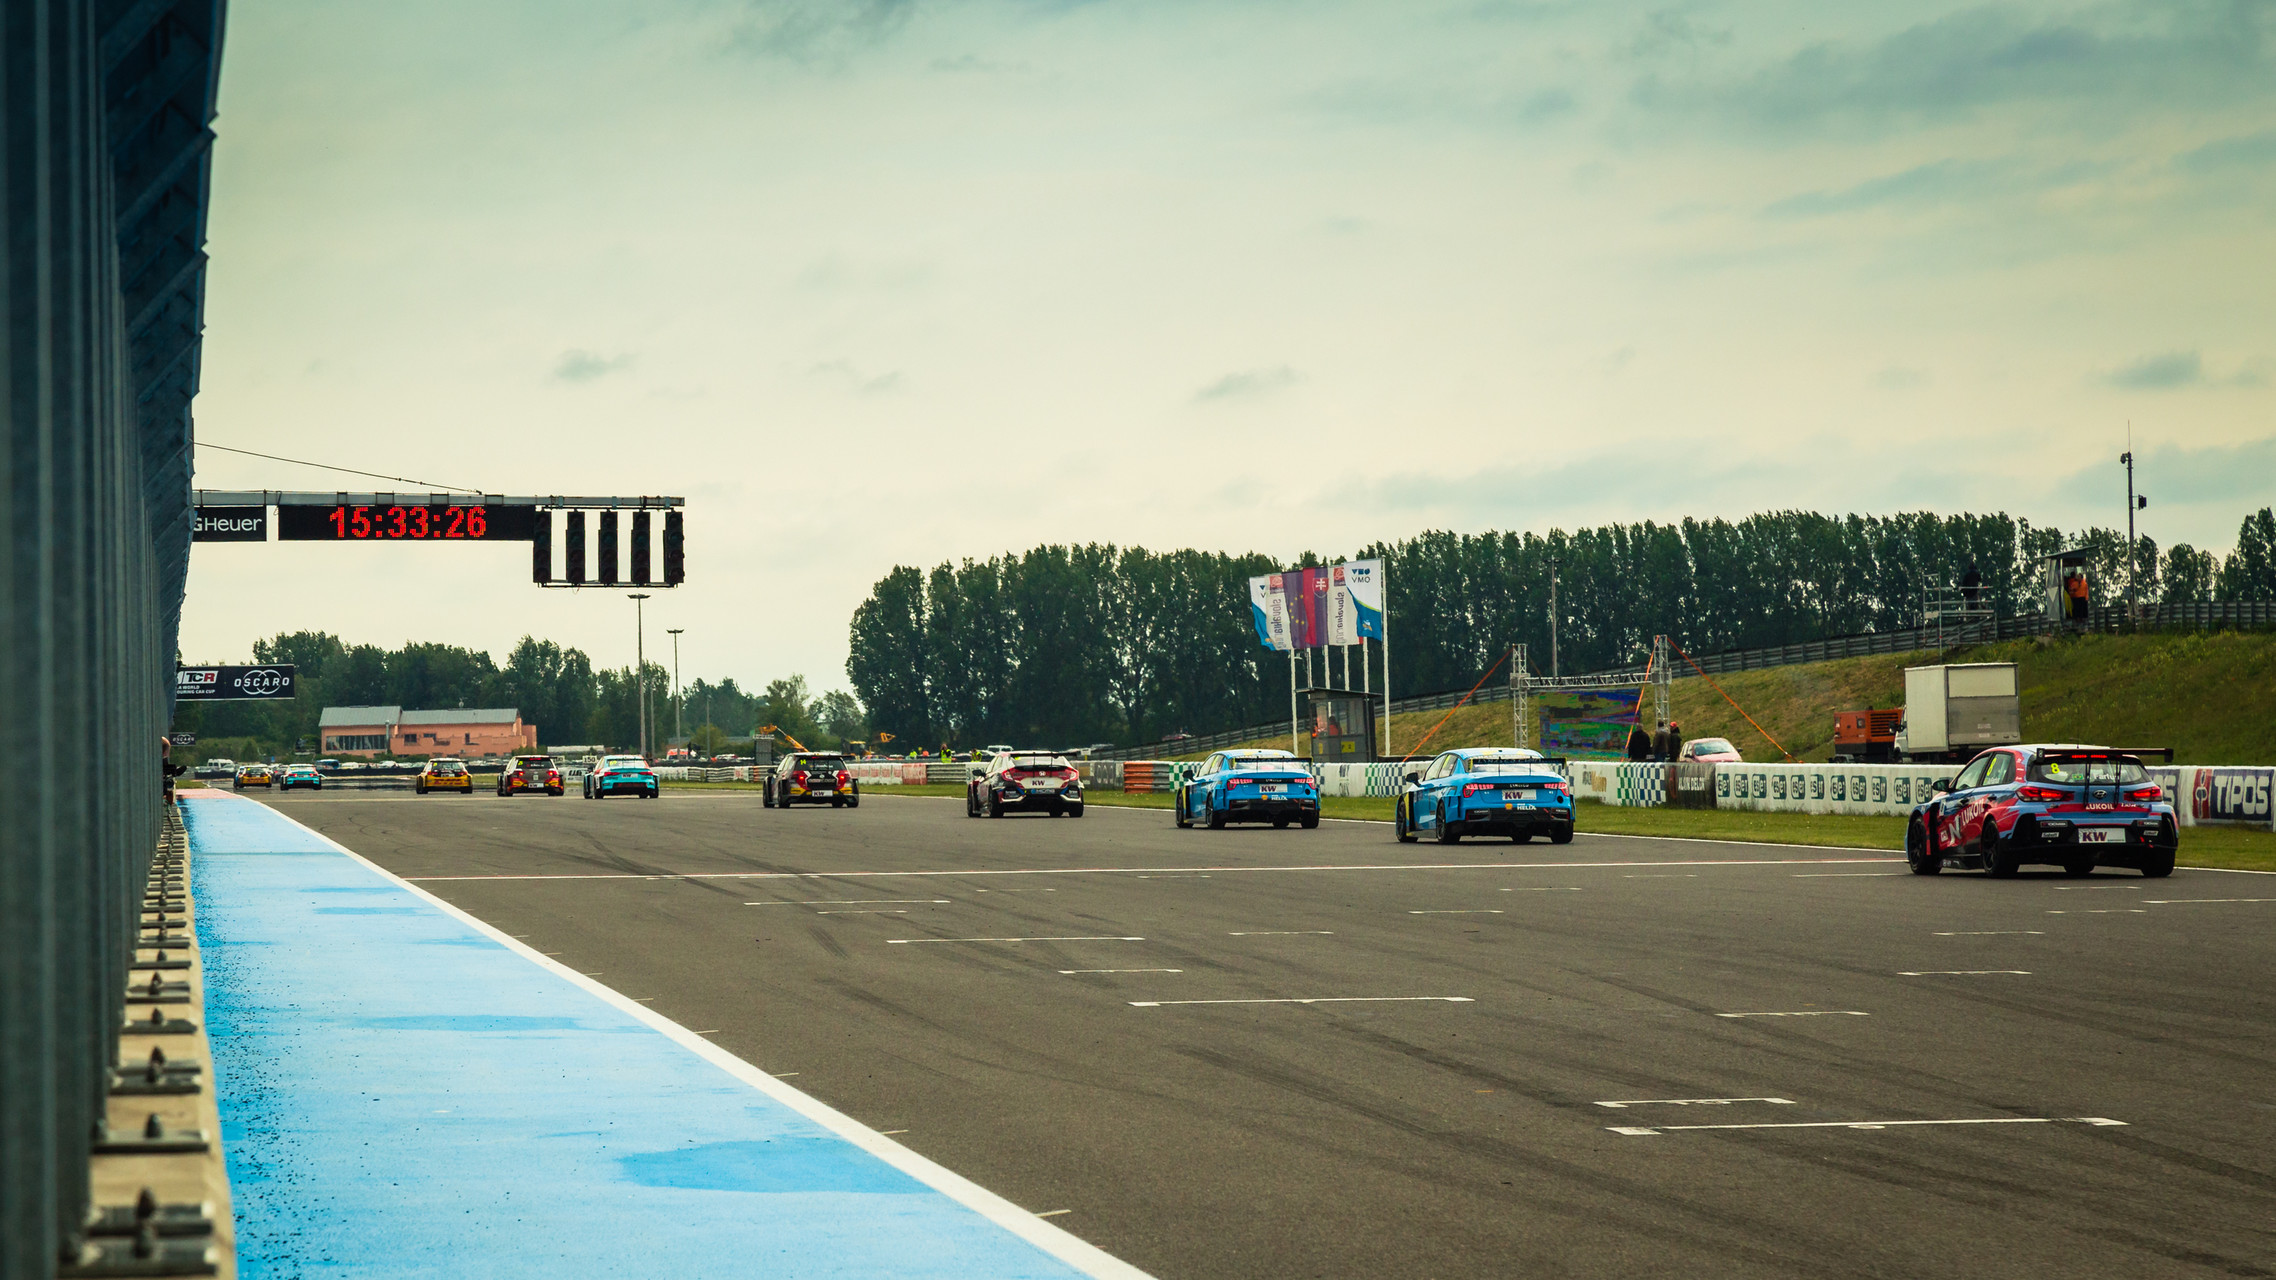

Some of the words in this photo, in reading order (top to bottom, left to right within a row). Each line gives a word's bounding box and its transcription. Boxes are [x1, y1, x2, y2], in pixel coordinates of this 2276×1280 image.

[329, 506, 487, 538] 15:33:26
[186, 673, 215, 682] TCR
[234, 677, 290, 687] OSCARO
[2050, 763, 2060, 774] 8
[2214, 775, 2269, 815] TIPOS
[1961, 798, 1985, 826] LUKOIL
[2082, 831, 2107, 841] KW
